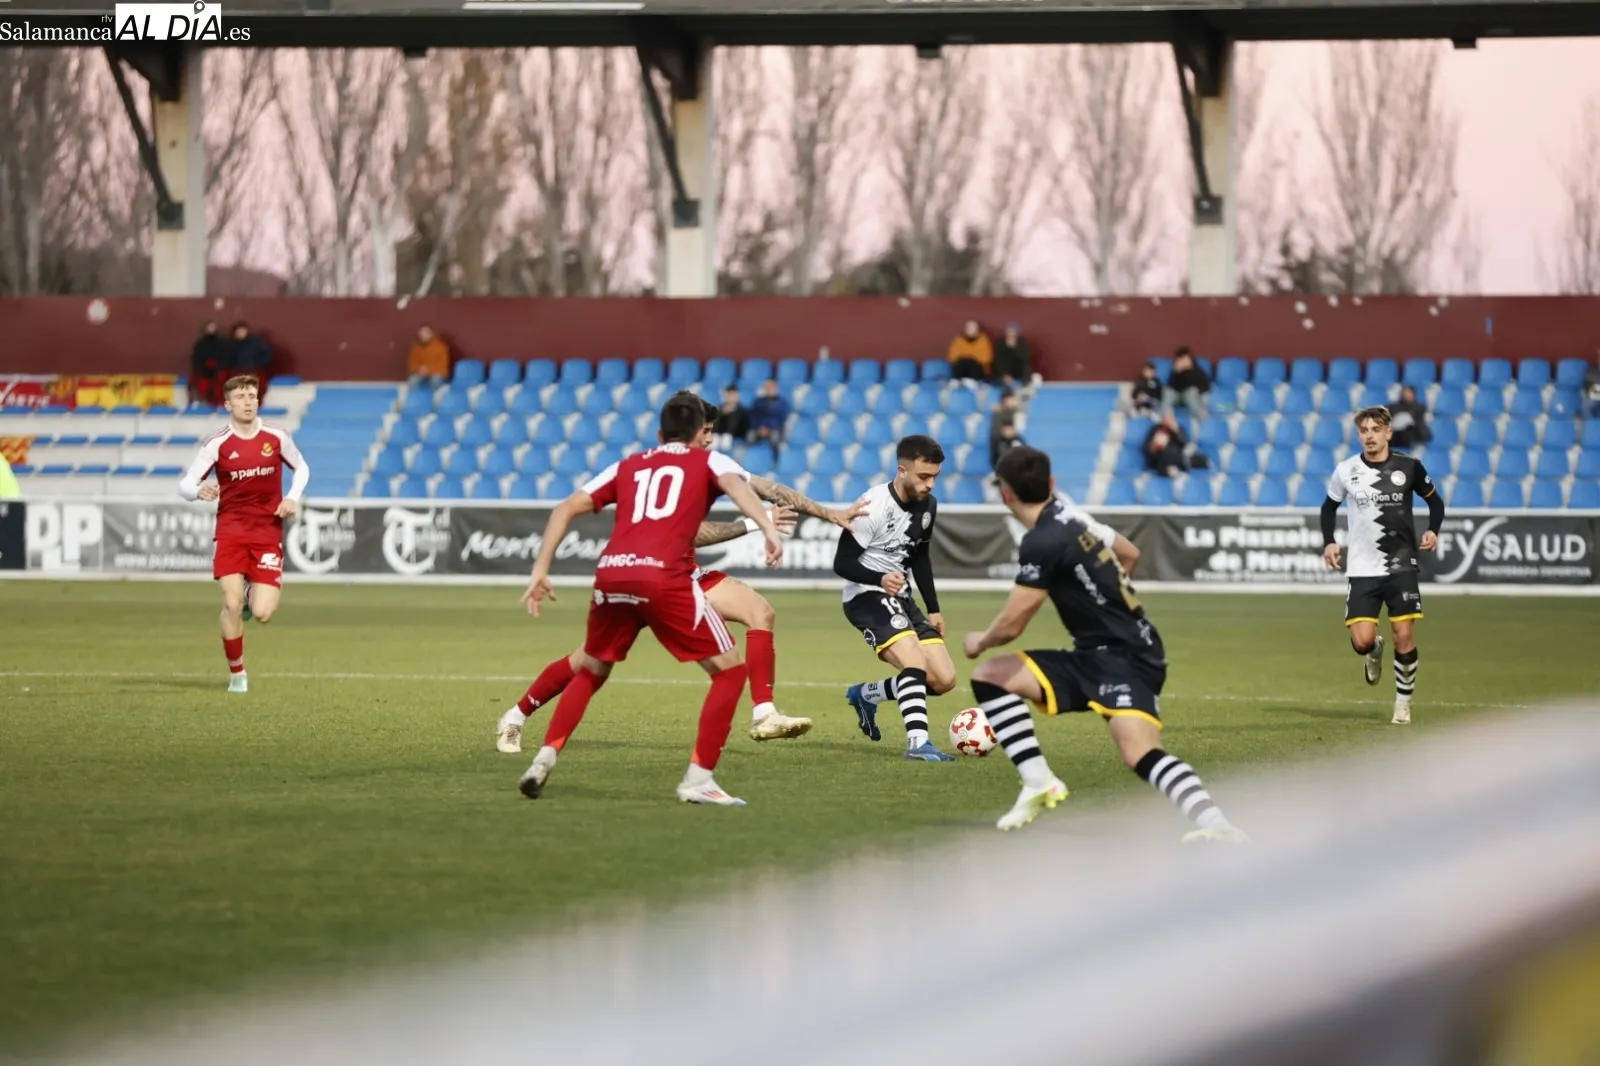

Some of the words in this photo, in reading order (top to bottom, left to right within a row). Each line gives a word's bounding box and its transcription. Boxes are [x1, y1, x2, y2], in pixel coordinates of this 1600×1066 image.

[631, 465, 685, 524] 10
[1372, 493, 1390, 502] Don
[1482, 533, 1587, 561] SALUD
[881, 596, 903, 615] 19
